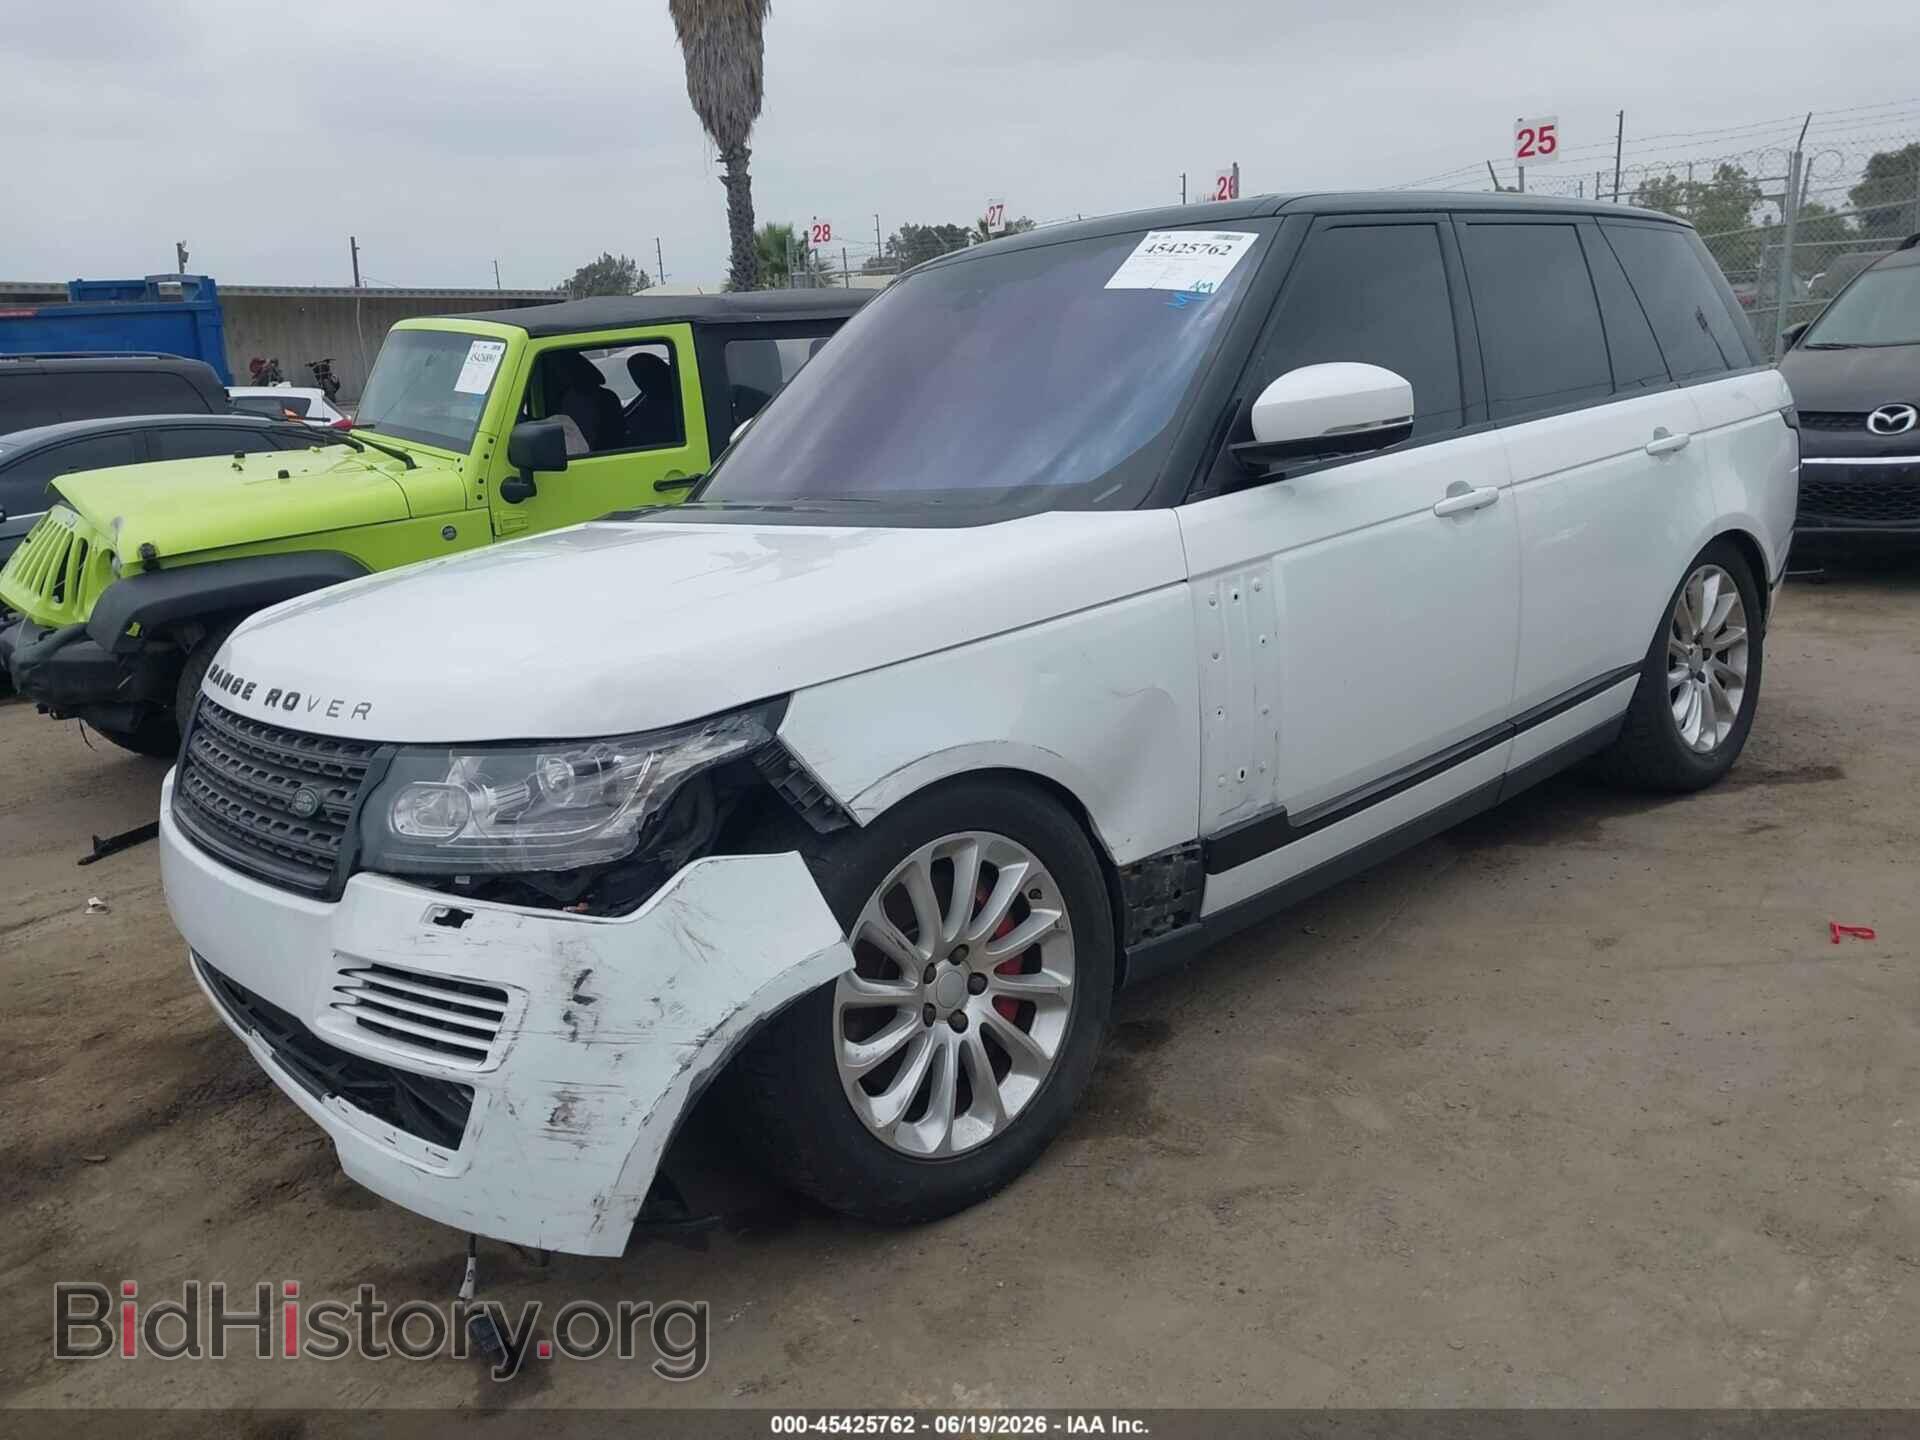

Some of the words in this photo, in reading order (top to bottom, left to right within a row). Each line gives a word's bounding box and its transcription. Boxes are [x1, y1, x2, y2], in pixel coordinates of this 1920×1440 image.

[1517, 125, 1556, 158] 25
[988, 204, 1004, 227] 27
[812, 223, 831, 243] 28
[1144, 243, 1232, 256] 45425762
[207, 663, 257, 701] RANGE
[264, 688, 372, 720] ROVER
